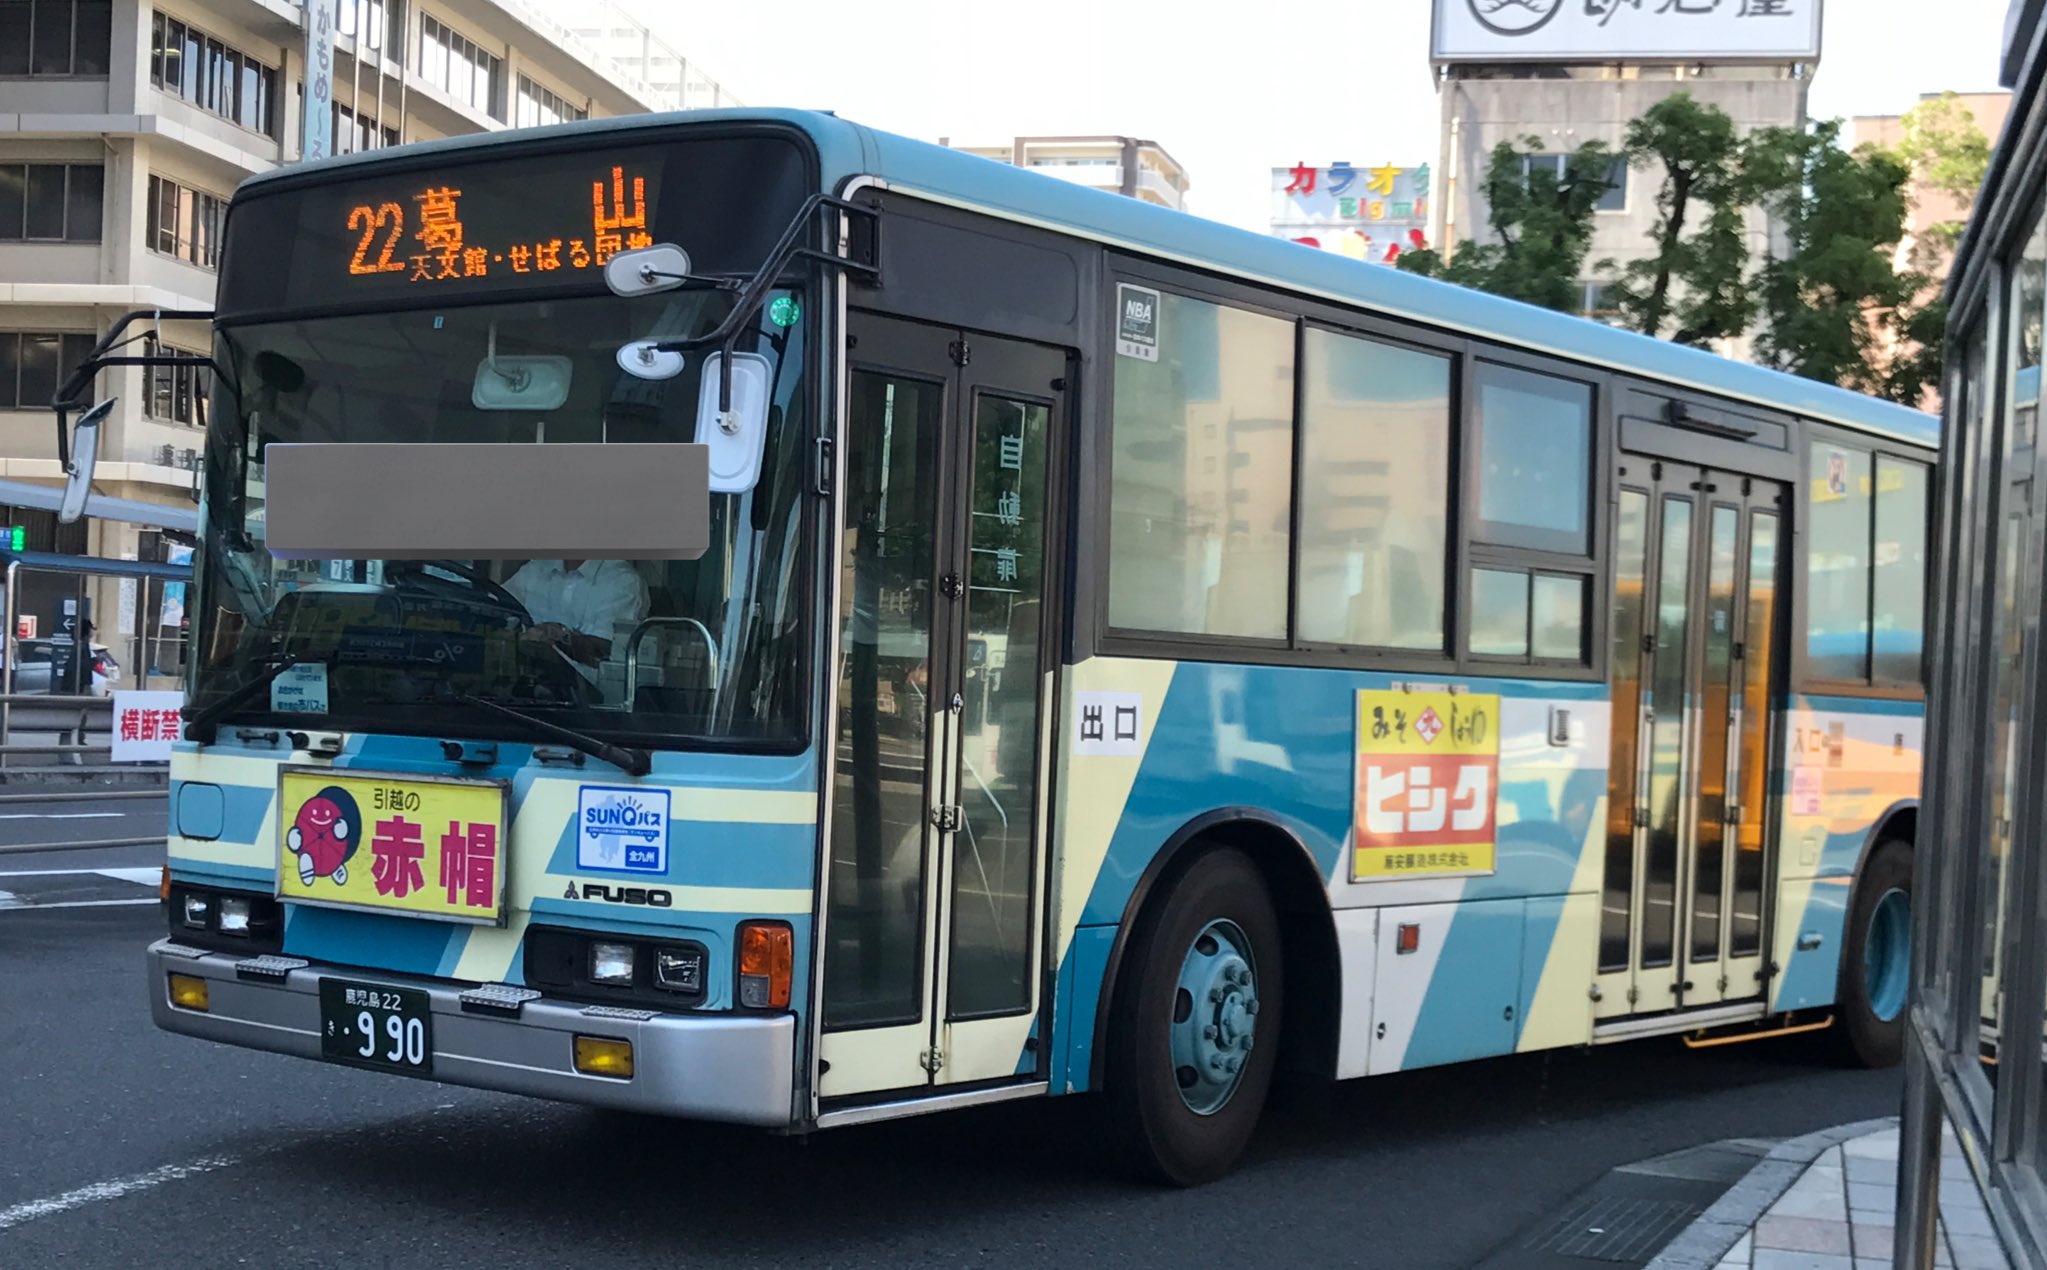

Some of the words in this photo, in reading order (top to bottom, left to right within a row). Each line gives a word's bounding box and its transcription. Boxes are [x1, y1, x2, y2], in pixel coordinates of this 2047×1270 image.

[348, 202, 405, 274] 22
[1126, 300, 1152, 321] NBA
[1081, 704, 1137, 742] 出口
[374, 788, 421, 812] 引越の
[1365, 765, 1489, 834] ヒシク
[371, 815, 497, 909] 赤帽
[629, 850, 656, 863] 全九州
[583, 884, 672, 907] FUSO
